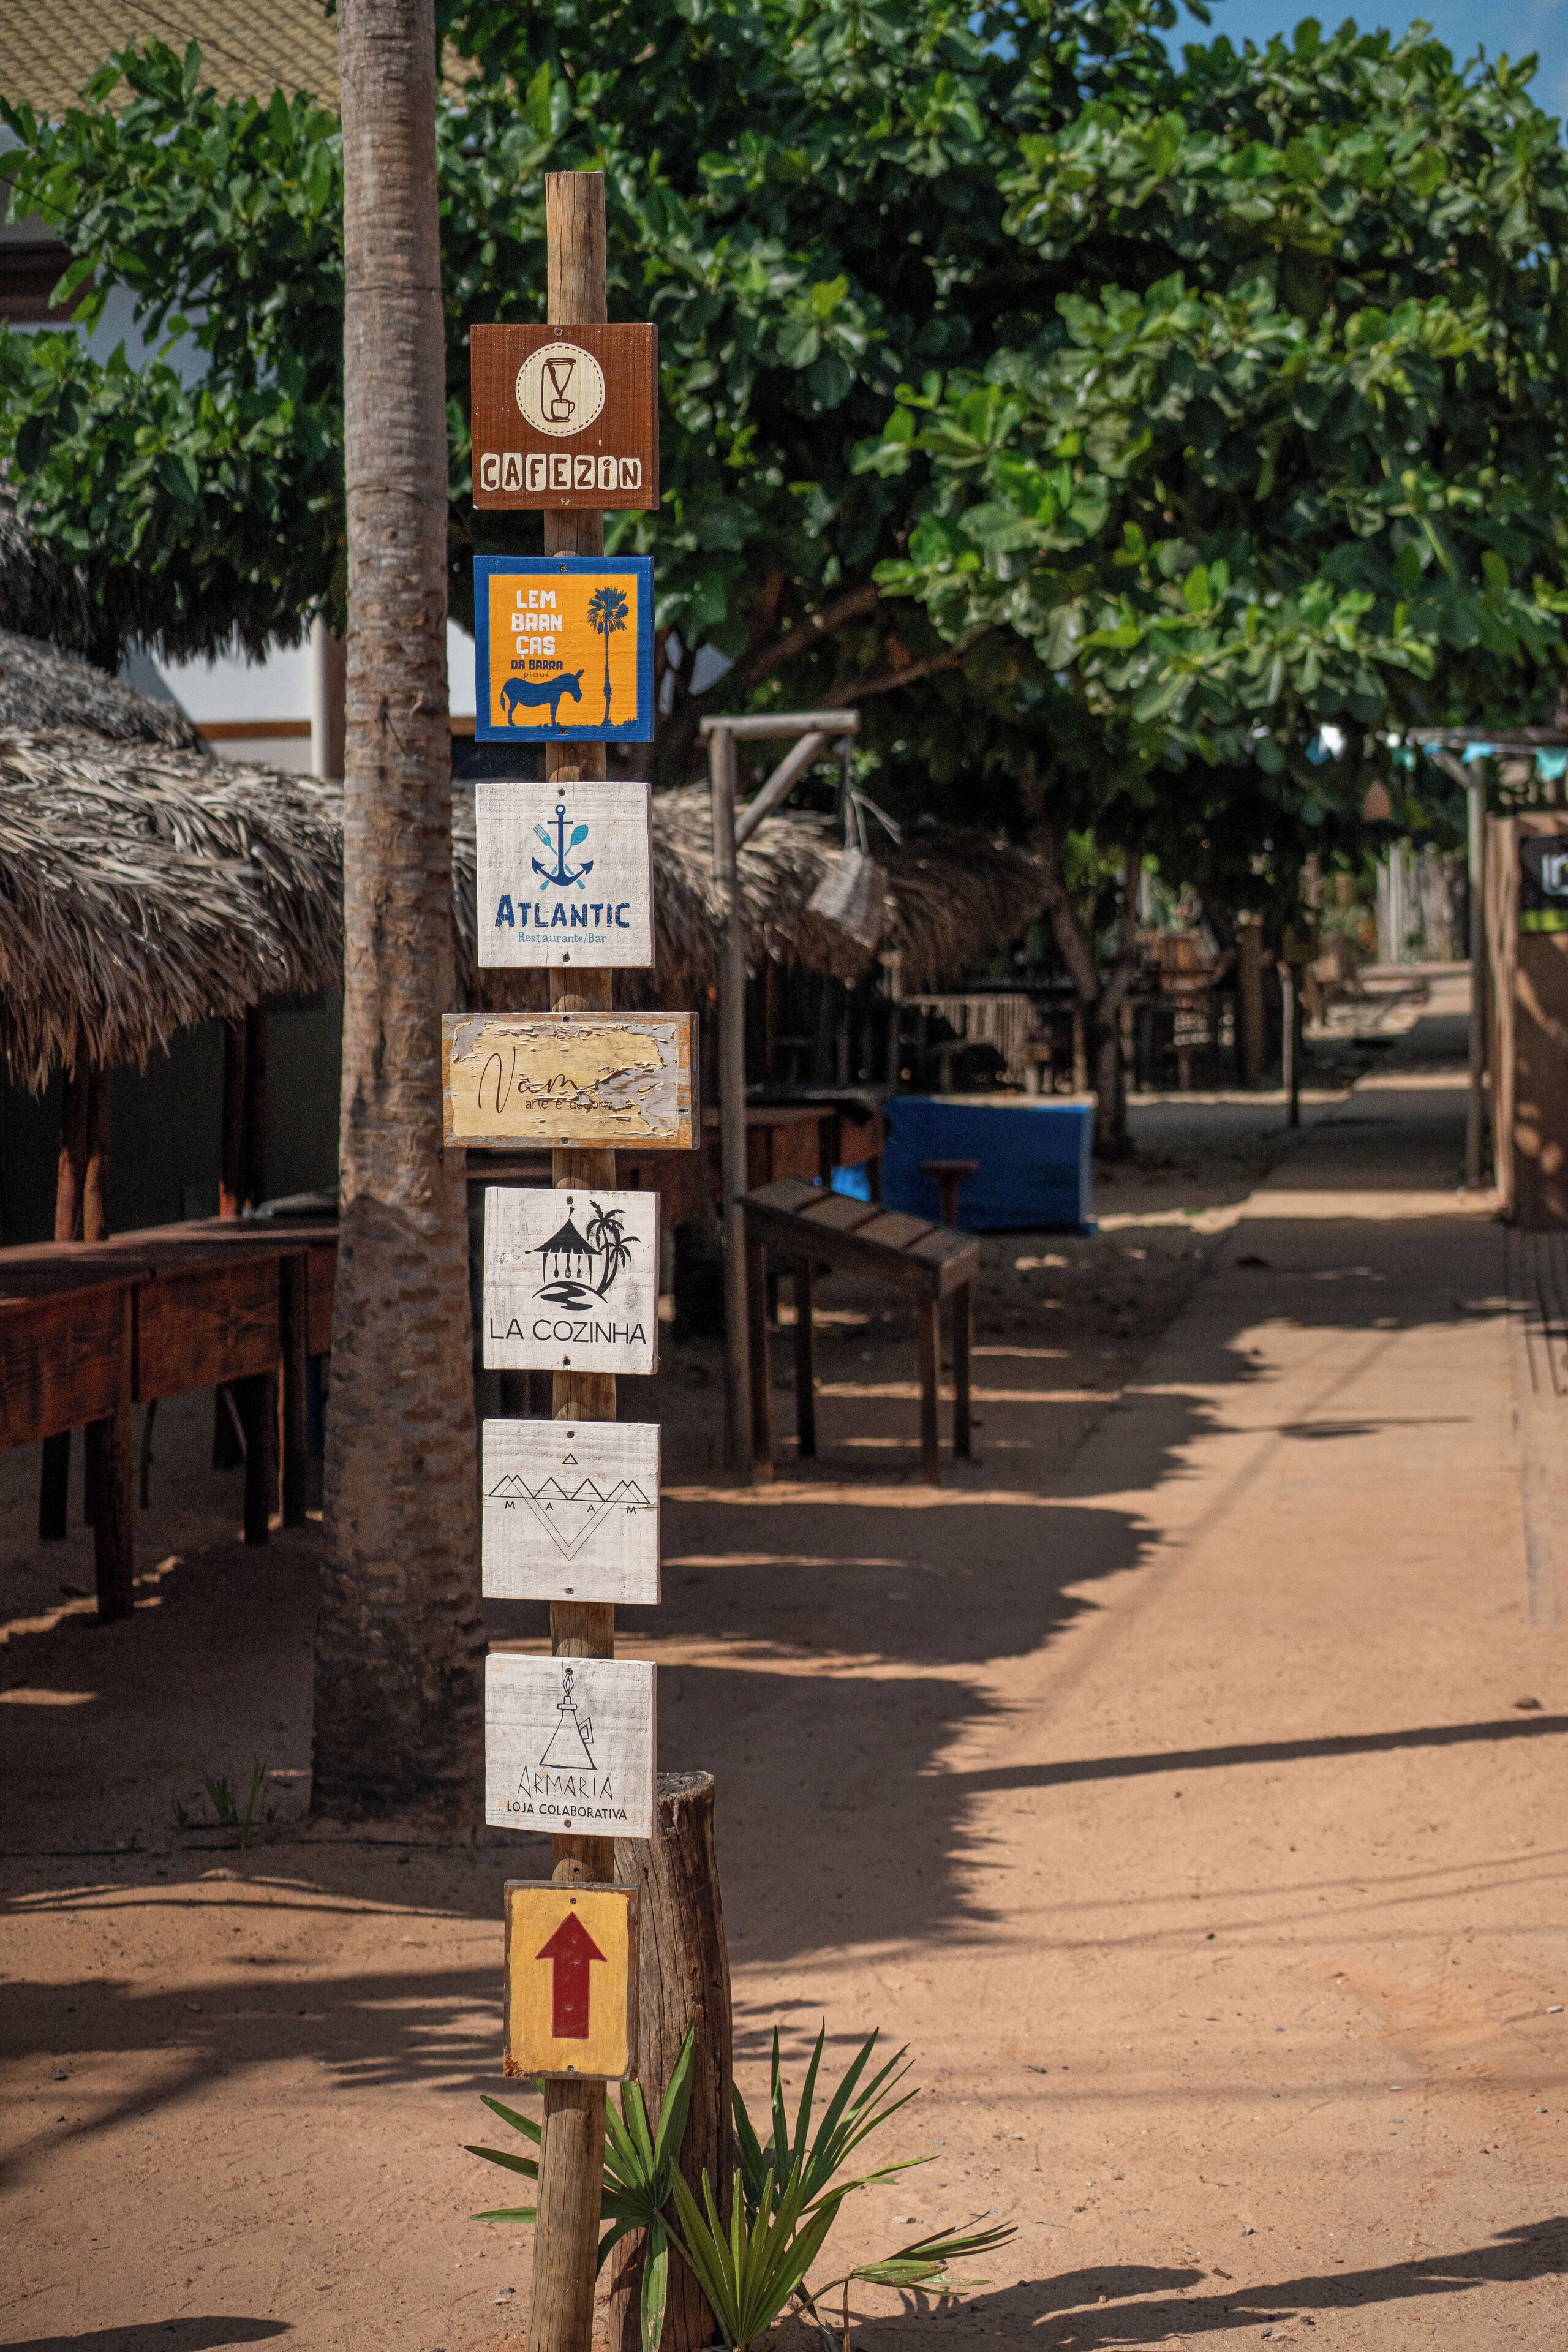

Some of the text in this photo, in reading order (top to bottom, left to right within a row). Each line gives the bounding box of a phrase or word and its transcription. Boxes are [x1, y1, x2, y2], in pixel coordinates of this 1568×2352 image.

[516, 590, 556, 608] LEM
[511, 612, 562, 632] BRAN
[516, 636, 556, 659] ÇAS
[511, 659, 563, 670] DA BARRA
[495, 894, 630, 928] ATLANTIC
[525, 1100, 549, 1110] arte
[490, 1318, 647, 1345] LA COZINHA
[517, 1765, 613, 1800] ARMARIA
[507, 1800, 627, 1820] LOJA COLABORATIVA
